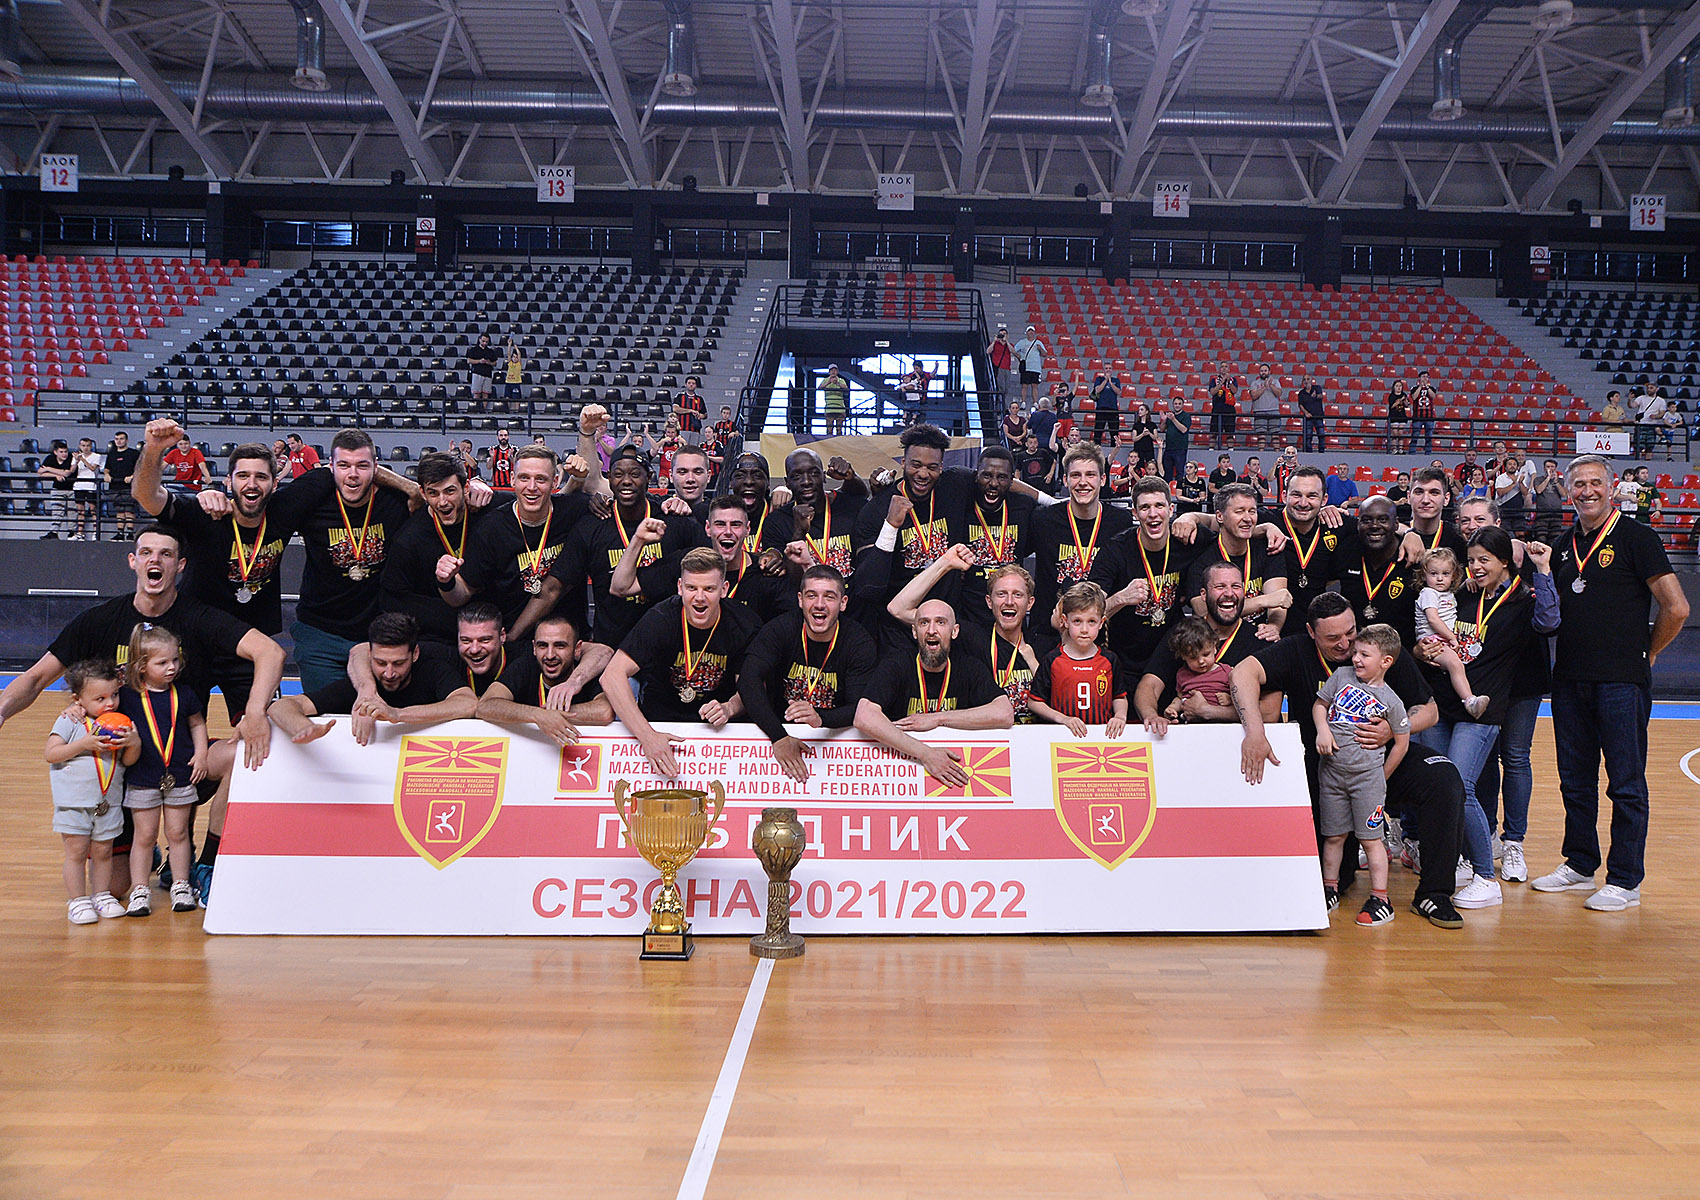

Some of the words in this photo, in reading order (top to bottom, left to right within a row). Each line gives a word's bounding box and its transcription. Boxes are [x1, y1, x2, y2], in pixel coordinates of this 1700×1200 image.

[43, 156, 76, 166] БЛОК
[51, 168, 69, 185] 12
[540, 168, 573, 177] БЛОК
[880, 176, 911, 184] БЛОК
[548, 180, 565, 197] 13
[1157, 183, 1189, 192] БЛОК
[1163, 194, 1181, 212] 14
[1632, 198, 1664, 206] БЛОК
[1639, 208, 1656, 226] 15
[1594, 440, 1612, 451] A6
[1077, 682, 1091, 710] 9
[611, 743, 696, 757] РАКОТНА
[701, 743, 776, 760] ФЕДЕРАЦ
[608, 761, 727, 775] MAZEISCHE
[738, 762, 817, 777] HANDL
[827, 763, 917, 777] FEDERATION
[607, 779, 716, 794] MCEDONIAN
[726, 780, 811, 795] HANDBALL
[820, 782, 918, 797] FEDERATION
[596, 812, 971, 858] ПБДНИК
[532, 877, 761, 919] СЕЗОНА
[788, 879, 1027, 919] 2021/2022
